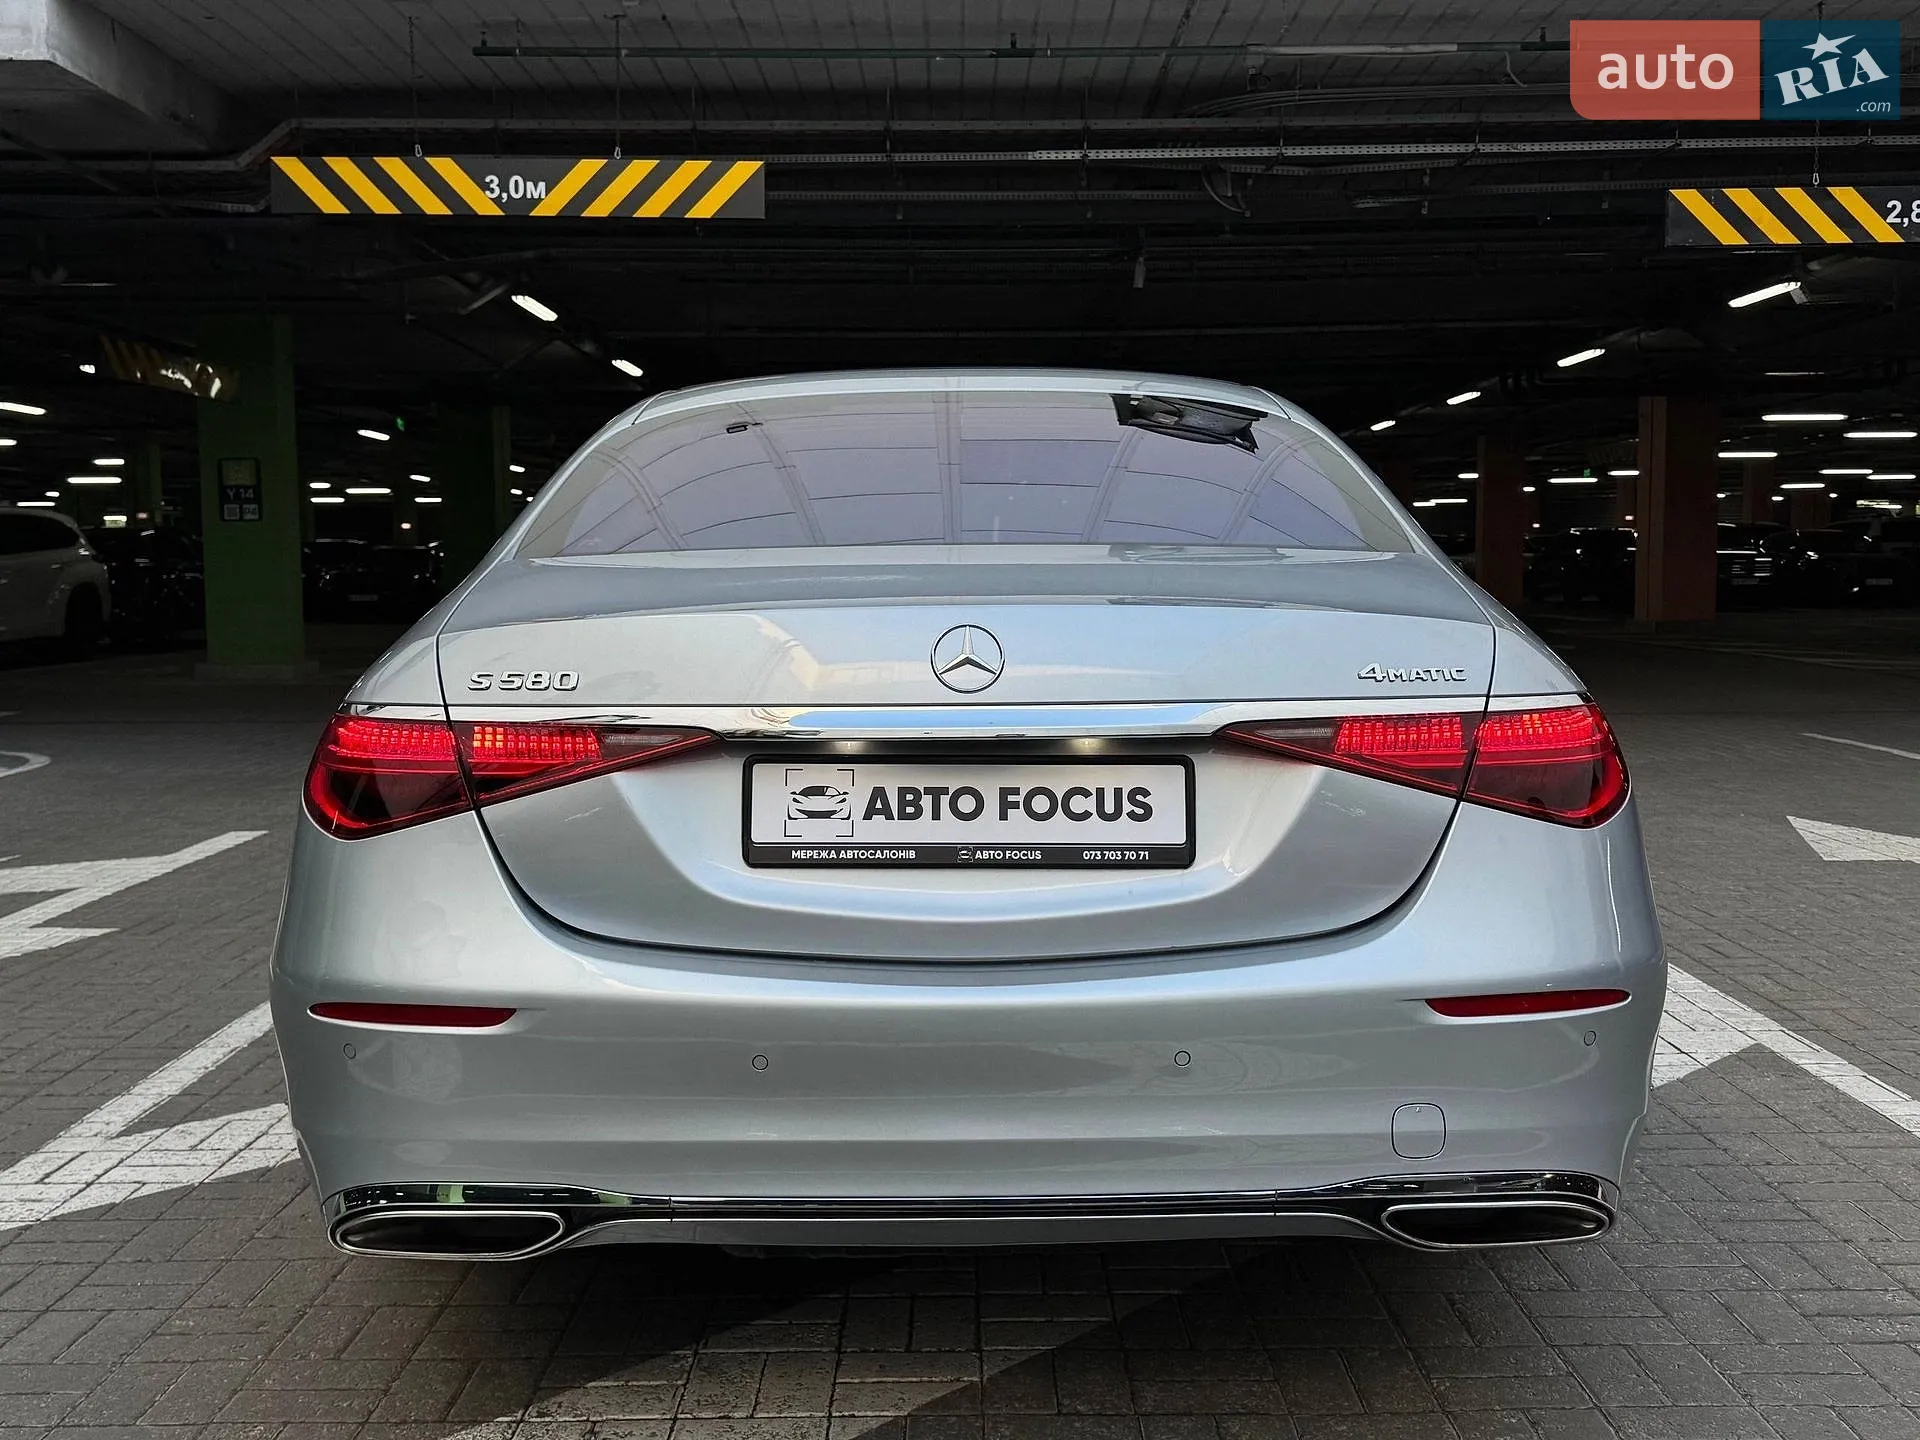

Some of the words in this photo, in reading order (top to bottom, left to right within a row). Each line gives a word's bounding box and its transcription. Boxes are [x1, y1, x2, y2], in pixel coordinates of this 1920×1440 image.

[484, 174, 546, 203] 3,0м
[467, 671, 494, 691] S
[498, 671, 579, 691] 580
[1357, 662, 1467, 682] 4MATIC
[862, 786, 985, 822] АВТО
[998, 786, 1154, 822] FOCUS
[791, 849, 837, 859] МЕРЕЖА
[839, 849, 916, 860] АВТОСАЛОНІВ
[1005, 850, 1042, 860] FOCUS
[1082, 850, 1101, 860] 073
[1103, 850, 1122, 860] 703
[1124, 850, 1137, 860] 70
[1138, 850, 1150, 860] 71
